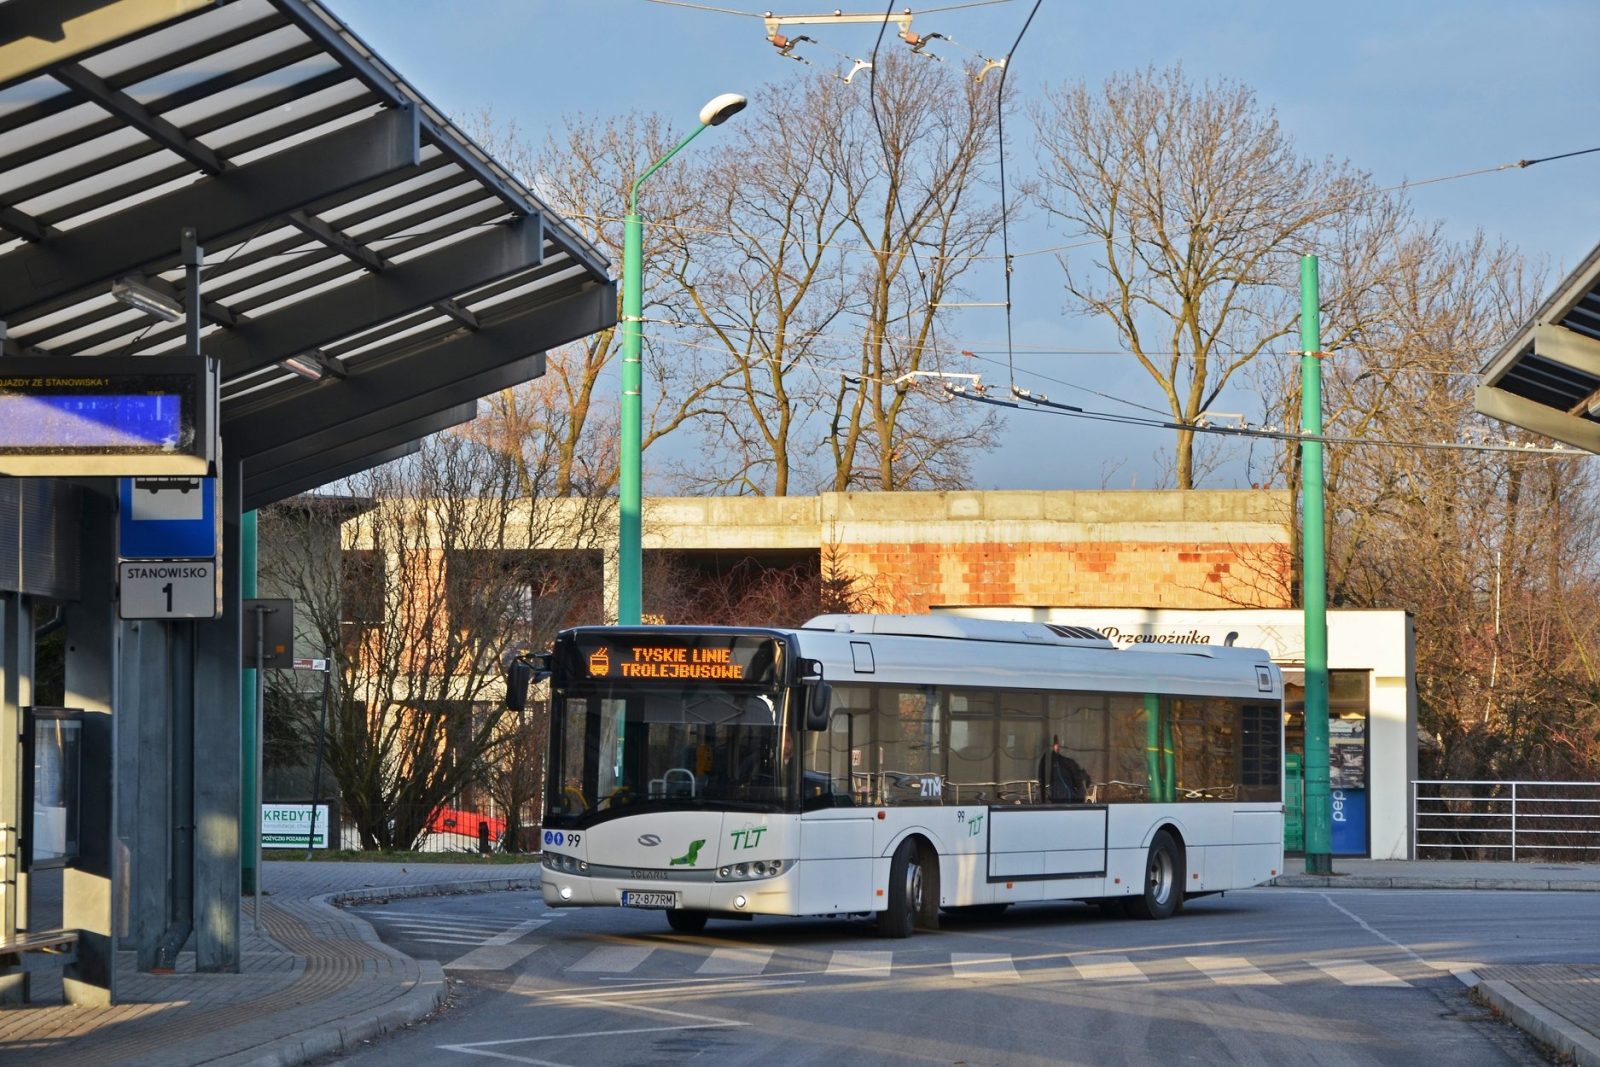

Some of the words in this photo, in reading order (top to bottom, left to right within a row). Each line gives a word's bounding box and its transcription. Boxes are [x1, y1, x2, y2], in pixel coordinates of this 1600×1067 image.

[0, 379, 30, 387] JAZDY
[45, 378, 103, 387] STANOWISKA
[127, 567, 207, 579] STANOWISKO
[162, 582, 173, 612] 1
[632, 647, 687, 663] TYSKIE
[693, 648, 731, 663] LINIE
[621, 663, 743, 679] TROLEJBUSOWE
[920, 776, 942, 796] ZTM
[264, 810, 321, 821] KREDYTY
[567, 833, 581, 847] 99
[731, 828, 767, 850] TLT
